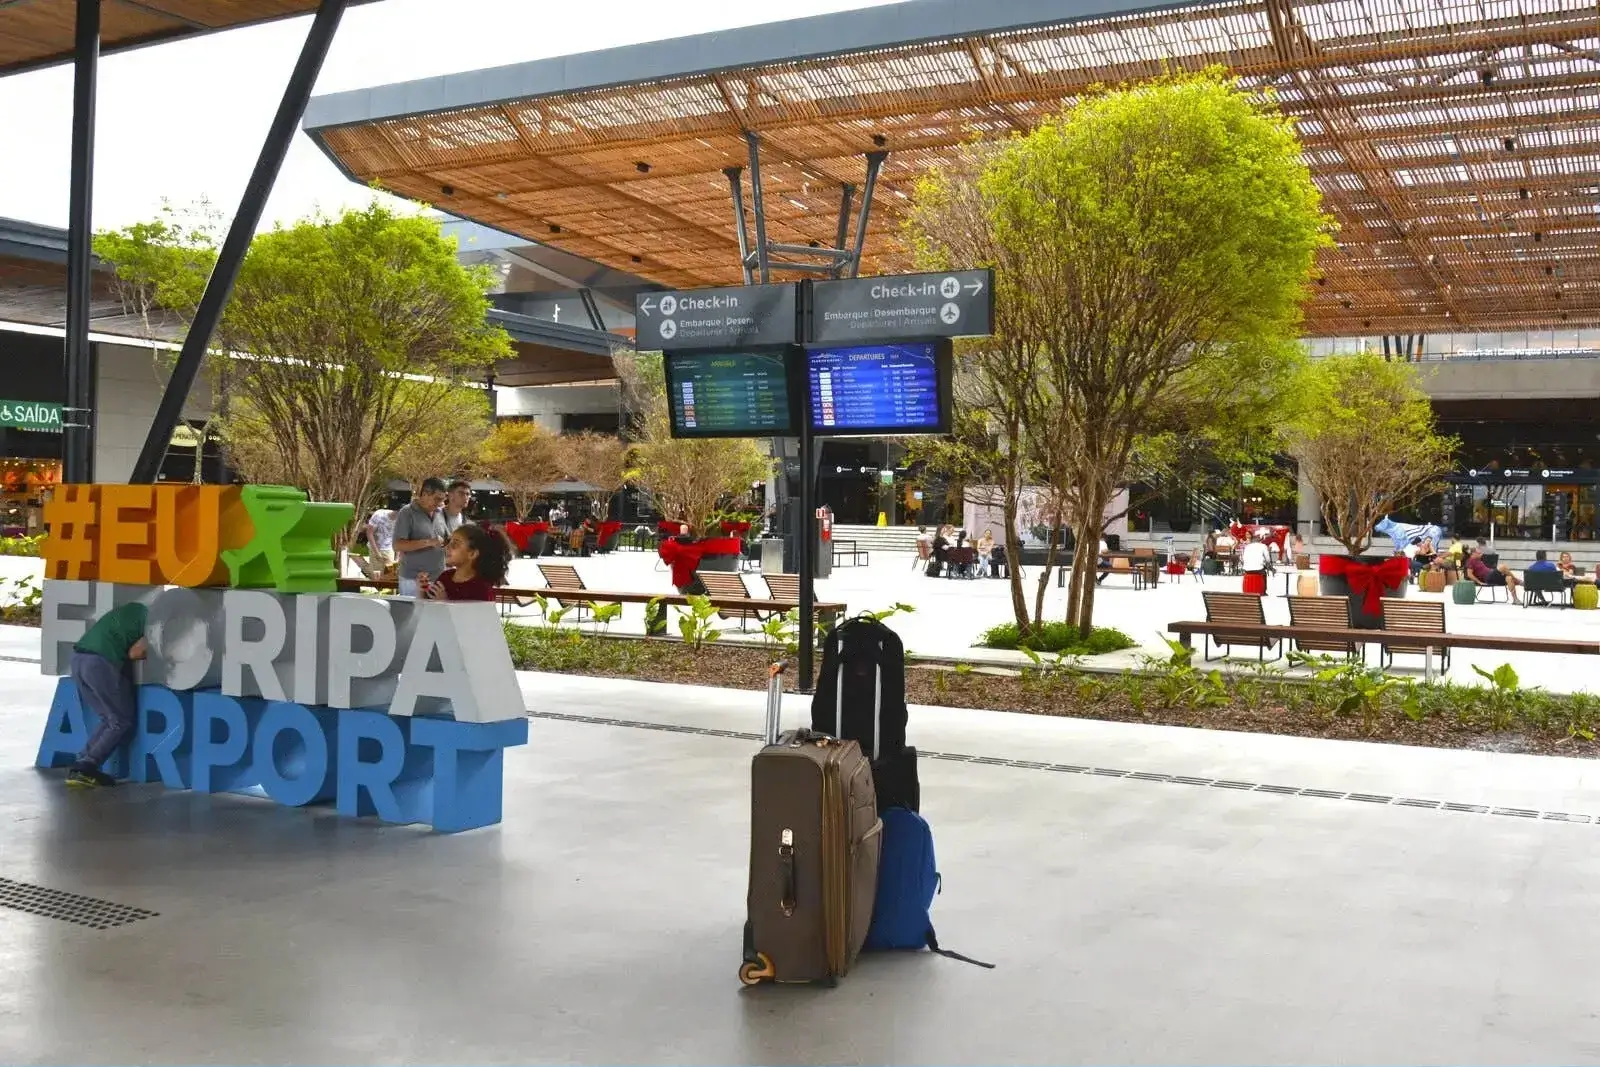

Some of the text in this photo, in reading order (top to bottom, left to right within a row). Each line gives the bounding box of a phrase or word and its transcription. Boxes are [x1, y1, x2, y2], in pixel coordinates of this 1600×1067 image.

[870, 282, 936, 300] Check-in
[680, 295, 739, 311] Check-in
[824, 306, 937, 321] Embarque Desembarque
[680, 318, 721, 329] Embarque
[848, 353, 886, 362] DEPARTURES
[14, 403, 60, 424] SAÍDA
[41, 484, 222, 588] #EU
[36, 676, 528, 833] ARPORT
